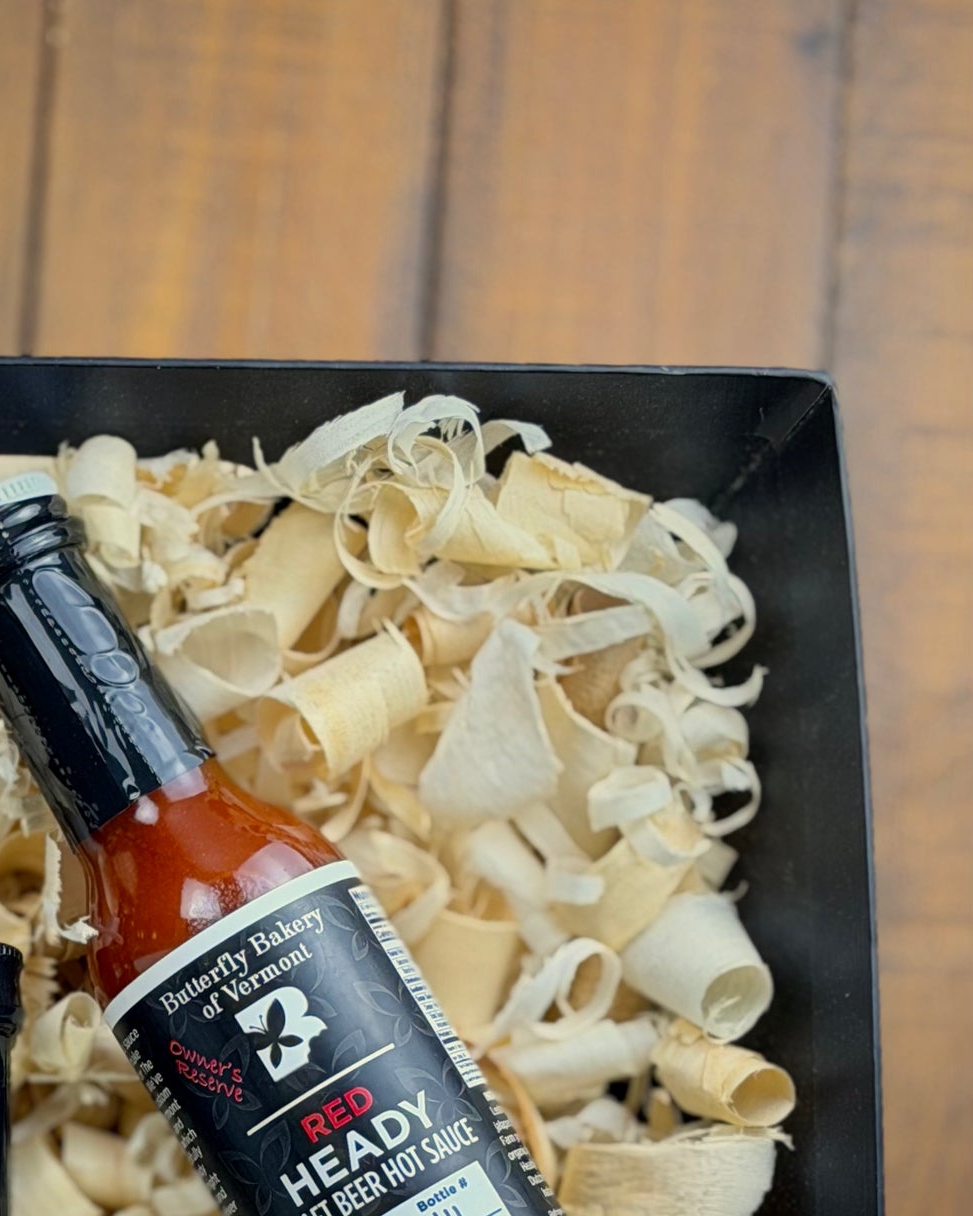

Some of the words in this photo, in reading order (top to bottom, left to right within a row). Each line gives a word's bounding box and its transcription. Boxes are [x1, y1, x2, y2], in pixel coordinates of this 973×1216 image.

[158, 949, 248, 1016] Butterfly
[247, 908, 324, 957] Bakery
[202, 992, 224, 1019] of
[220, 942, 312, 1002] Vermont
[169, 1038, 243, 1084] Owner's
[175, 1058, 243, 1104] Reserve
[300, 1086, 373, 1143] RED
[279, 1089, 433, 1208] HEADY
[381, 1145, 425, 1187] HOT
[421, 1117, 479, 1164] SAUCE
[417, 1186, 458, 1213] Bottle
[459, 1176, 469, 1189] #
